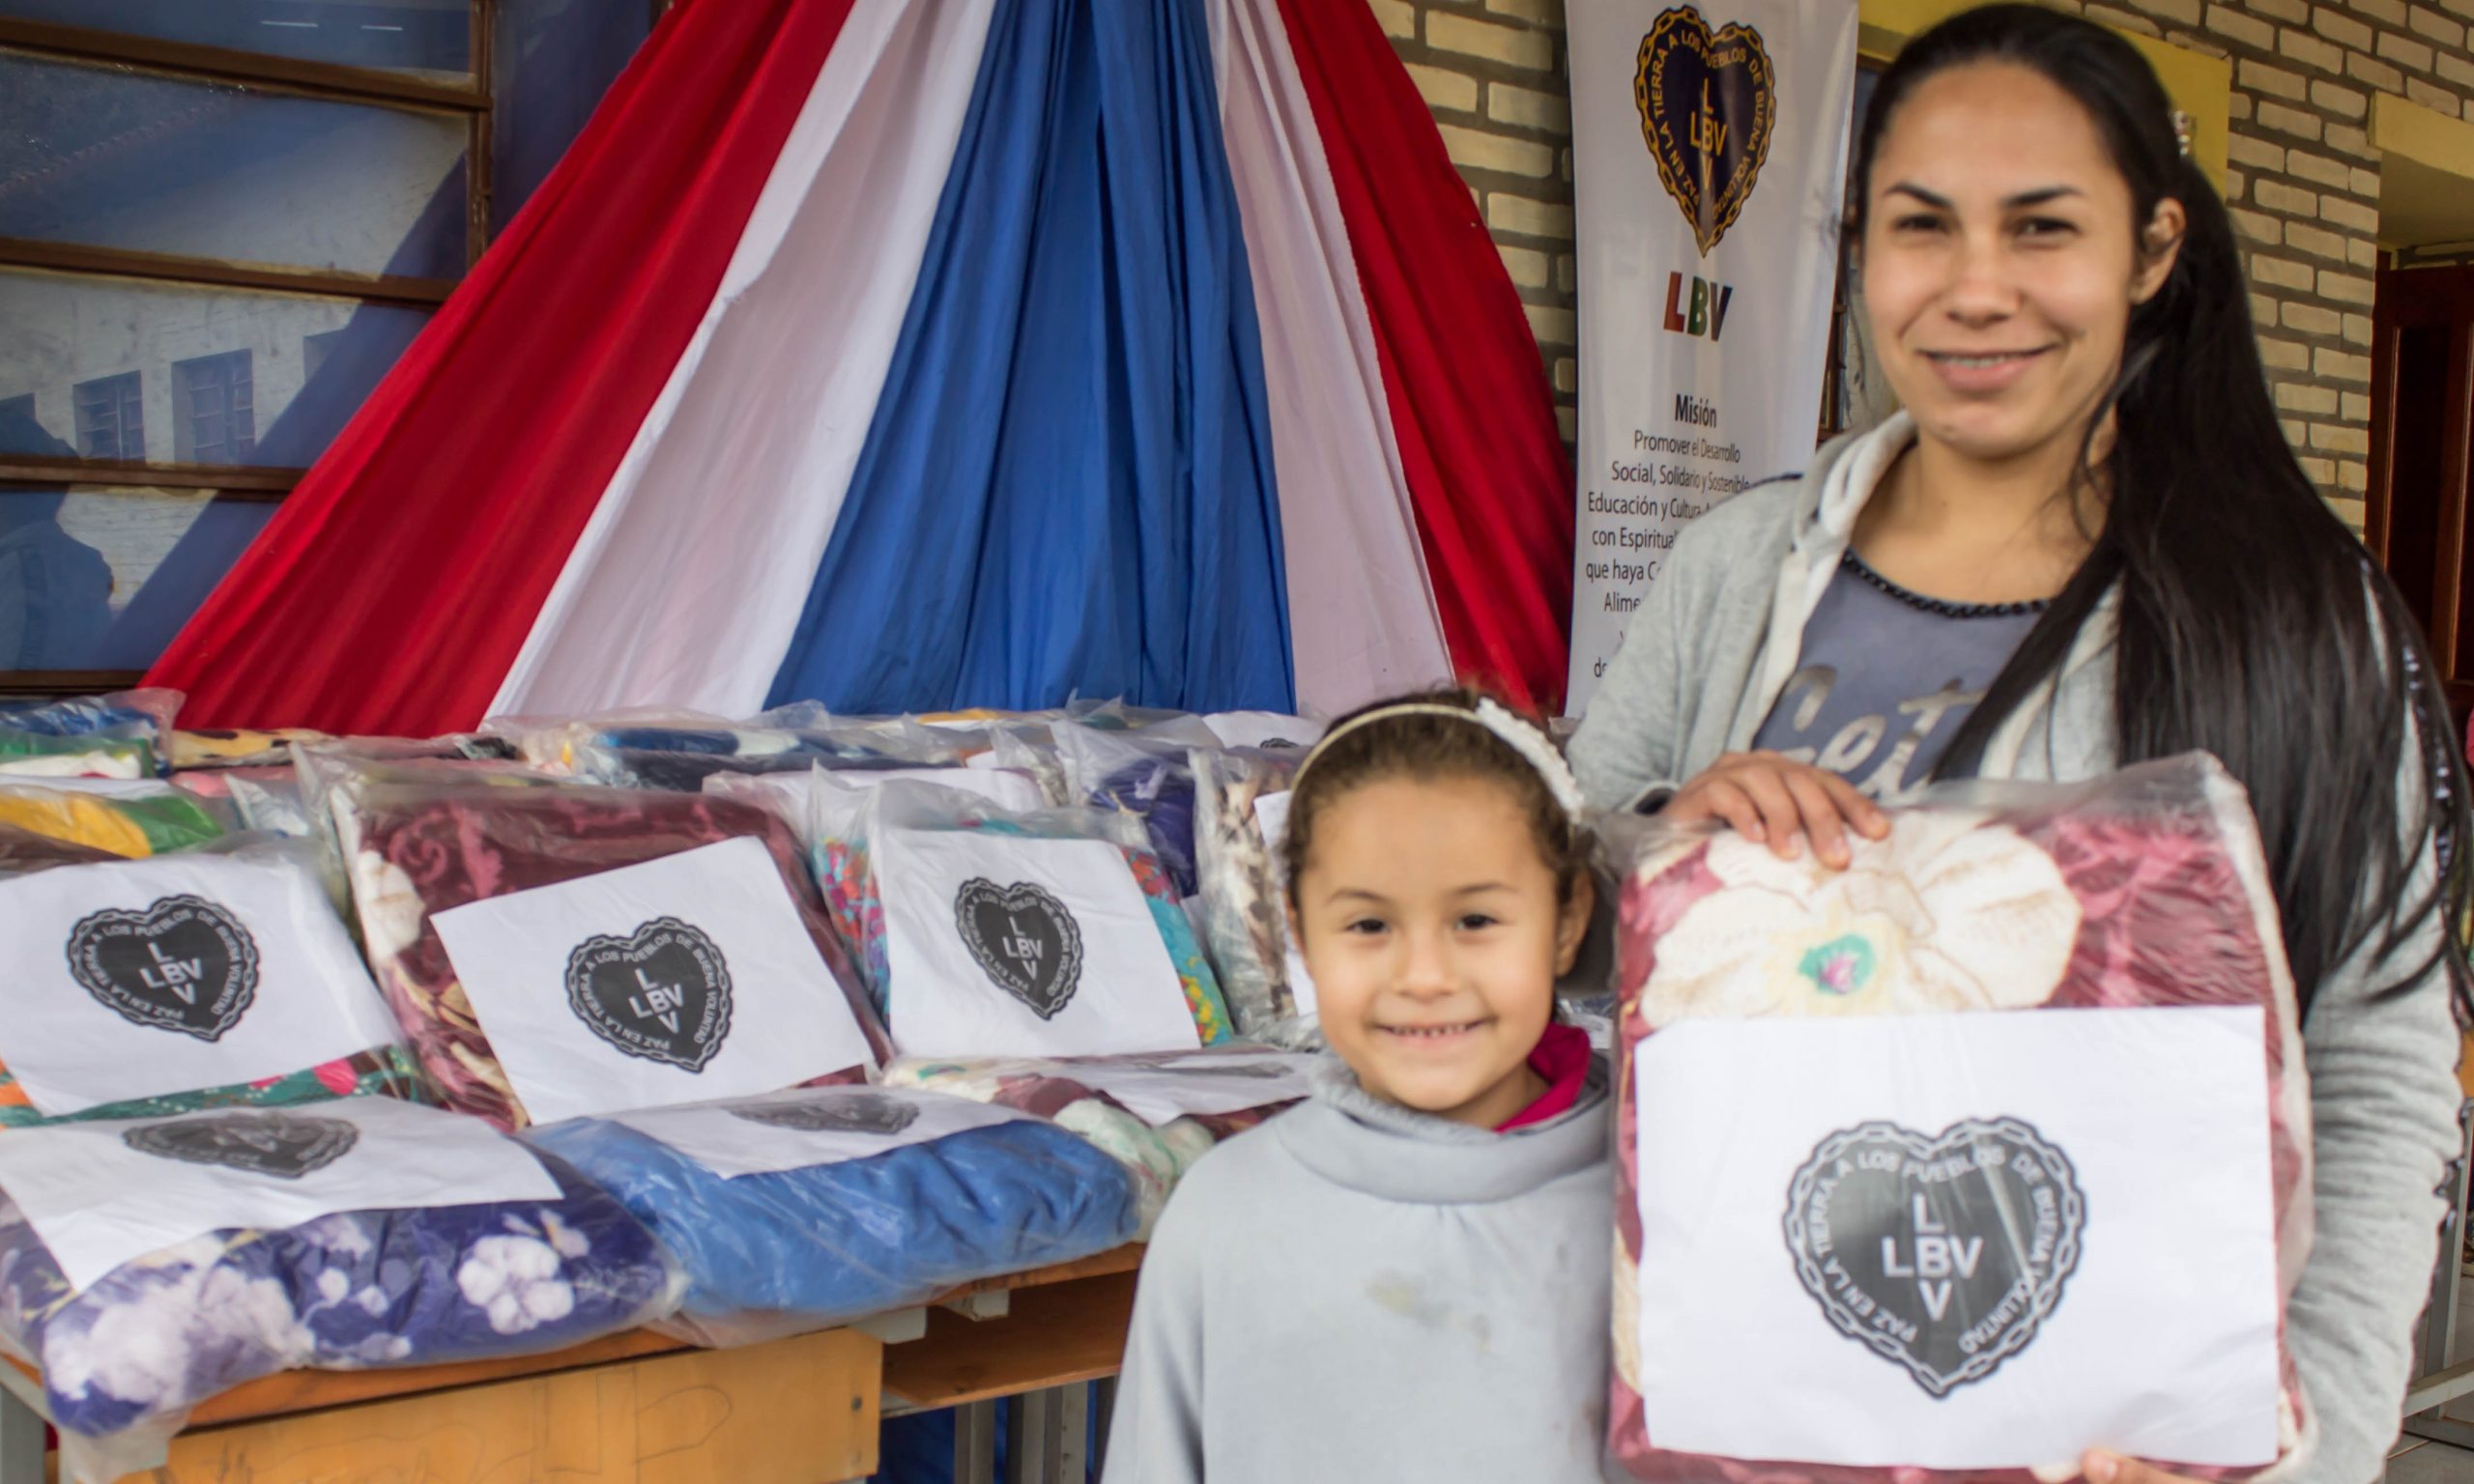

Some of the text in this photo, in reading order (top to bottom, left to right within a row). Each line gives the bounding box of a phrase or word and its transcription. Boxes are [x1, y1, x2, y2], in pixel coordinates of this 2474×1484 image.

[1668, 33, 1679, 49] A
[1701, 45, 1747, 69] PUEBLOS
[1651, 48, 1669, 120] TIERRA
[1748, 58, 1764, 85] DE
[1659, 121, 1674, 149] LA
[1690, 111, 1729, 157] LBV
[1746, 90, 1766, 151] BUENA
[1663, 271, 1734, 343] LBV
[1674, 392, 1717, 428] Misión
[1633, 429, 1740, 464] Promover el Desarrollo
[1611, 460, 1656, 487] Social,
[1659, 464, 1701, 489] Solidario
[1701, 476, 1708, 495] y
[1588, 490, 1657, 517] Educación
[1660, 503, 1668, 523] y
[1592, 528, 1616, 547] con
[1586, 557, 1662, 585] que haya C
[1002, 935, 1044, 960] LBV
[138, 957, 203, 989] LBV
[580, 932, 718, 1051] PAZ EN LA TIERRA A LOS PUEBLOS DE BUENA VOLUNTAD
[628, 983, 684, 1019] LBV
[1809, 1144, 2058, 1355] PAZ EN LA TIERRA A LOS PUEBLOS DE BUENA VOLUNTAD
[1881, 1236, 1983, 1279] LBV
